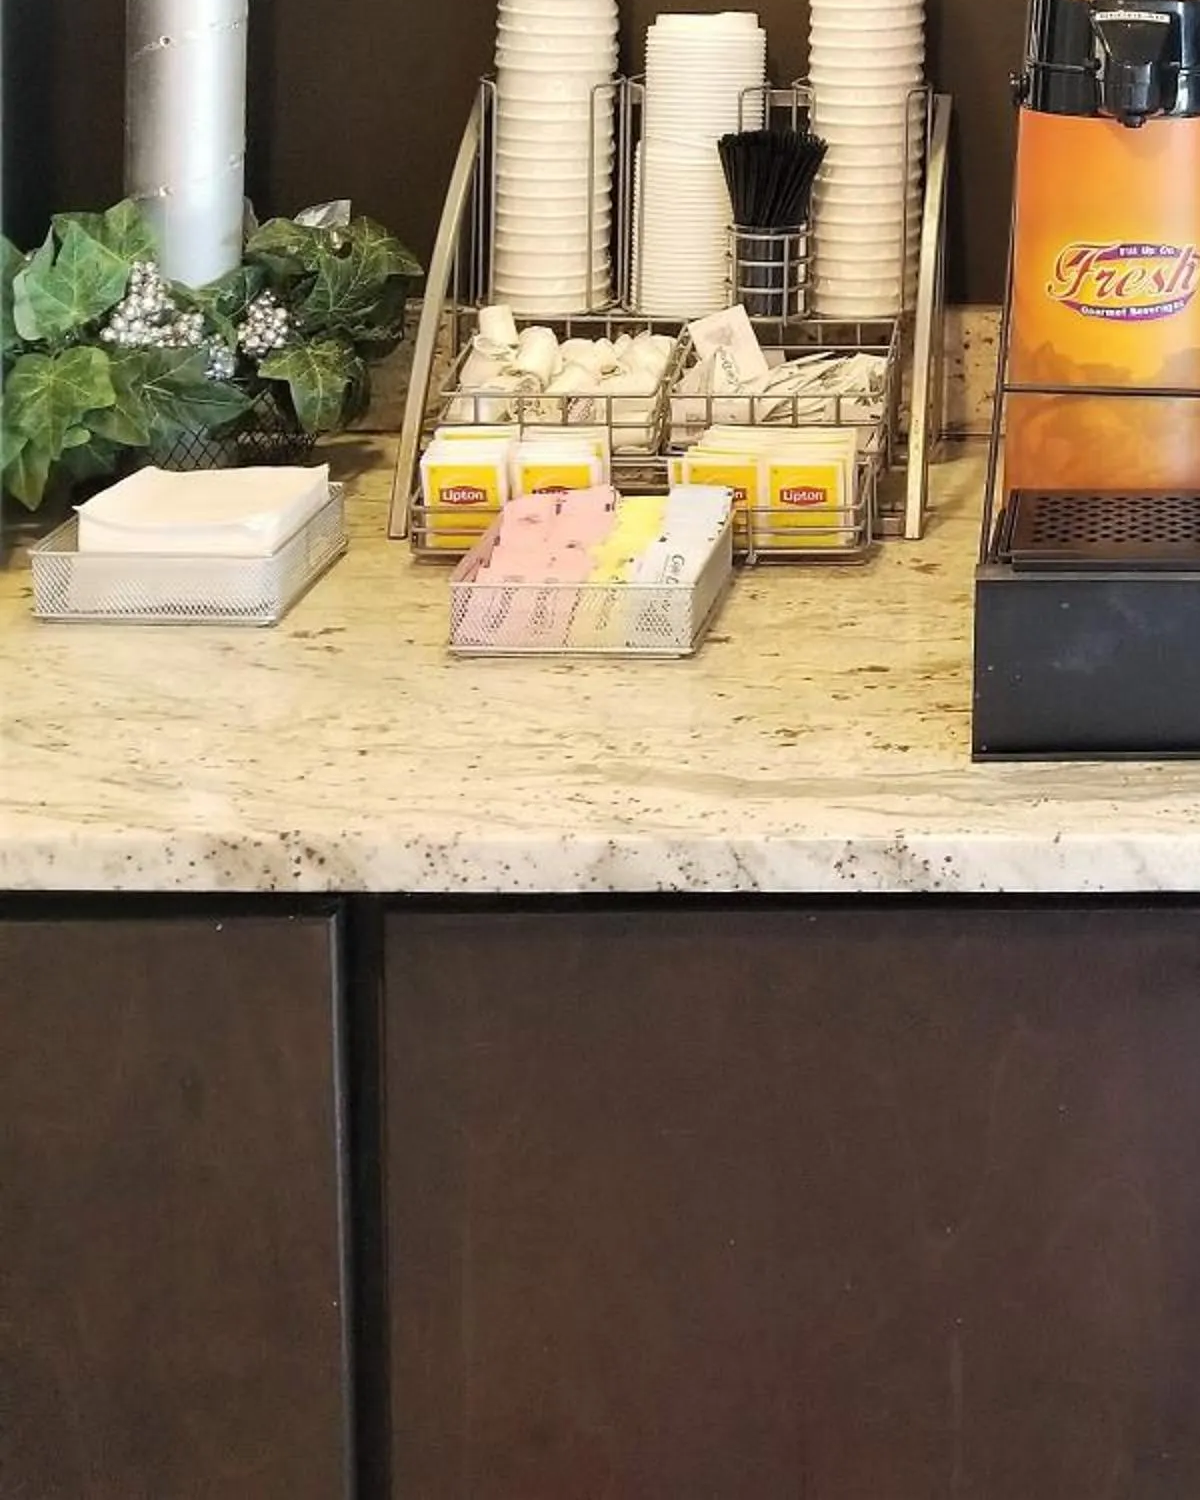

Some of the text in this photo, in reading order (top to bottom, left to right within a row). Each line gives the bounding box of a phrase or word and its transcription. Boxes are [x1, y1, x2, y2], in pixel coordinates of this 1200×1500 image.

[1080, 305, 1127, 317] Gourmet
[442, 489, 484, 503] Lipton
[783, 490, 824, 503] Lipton
